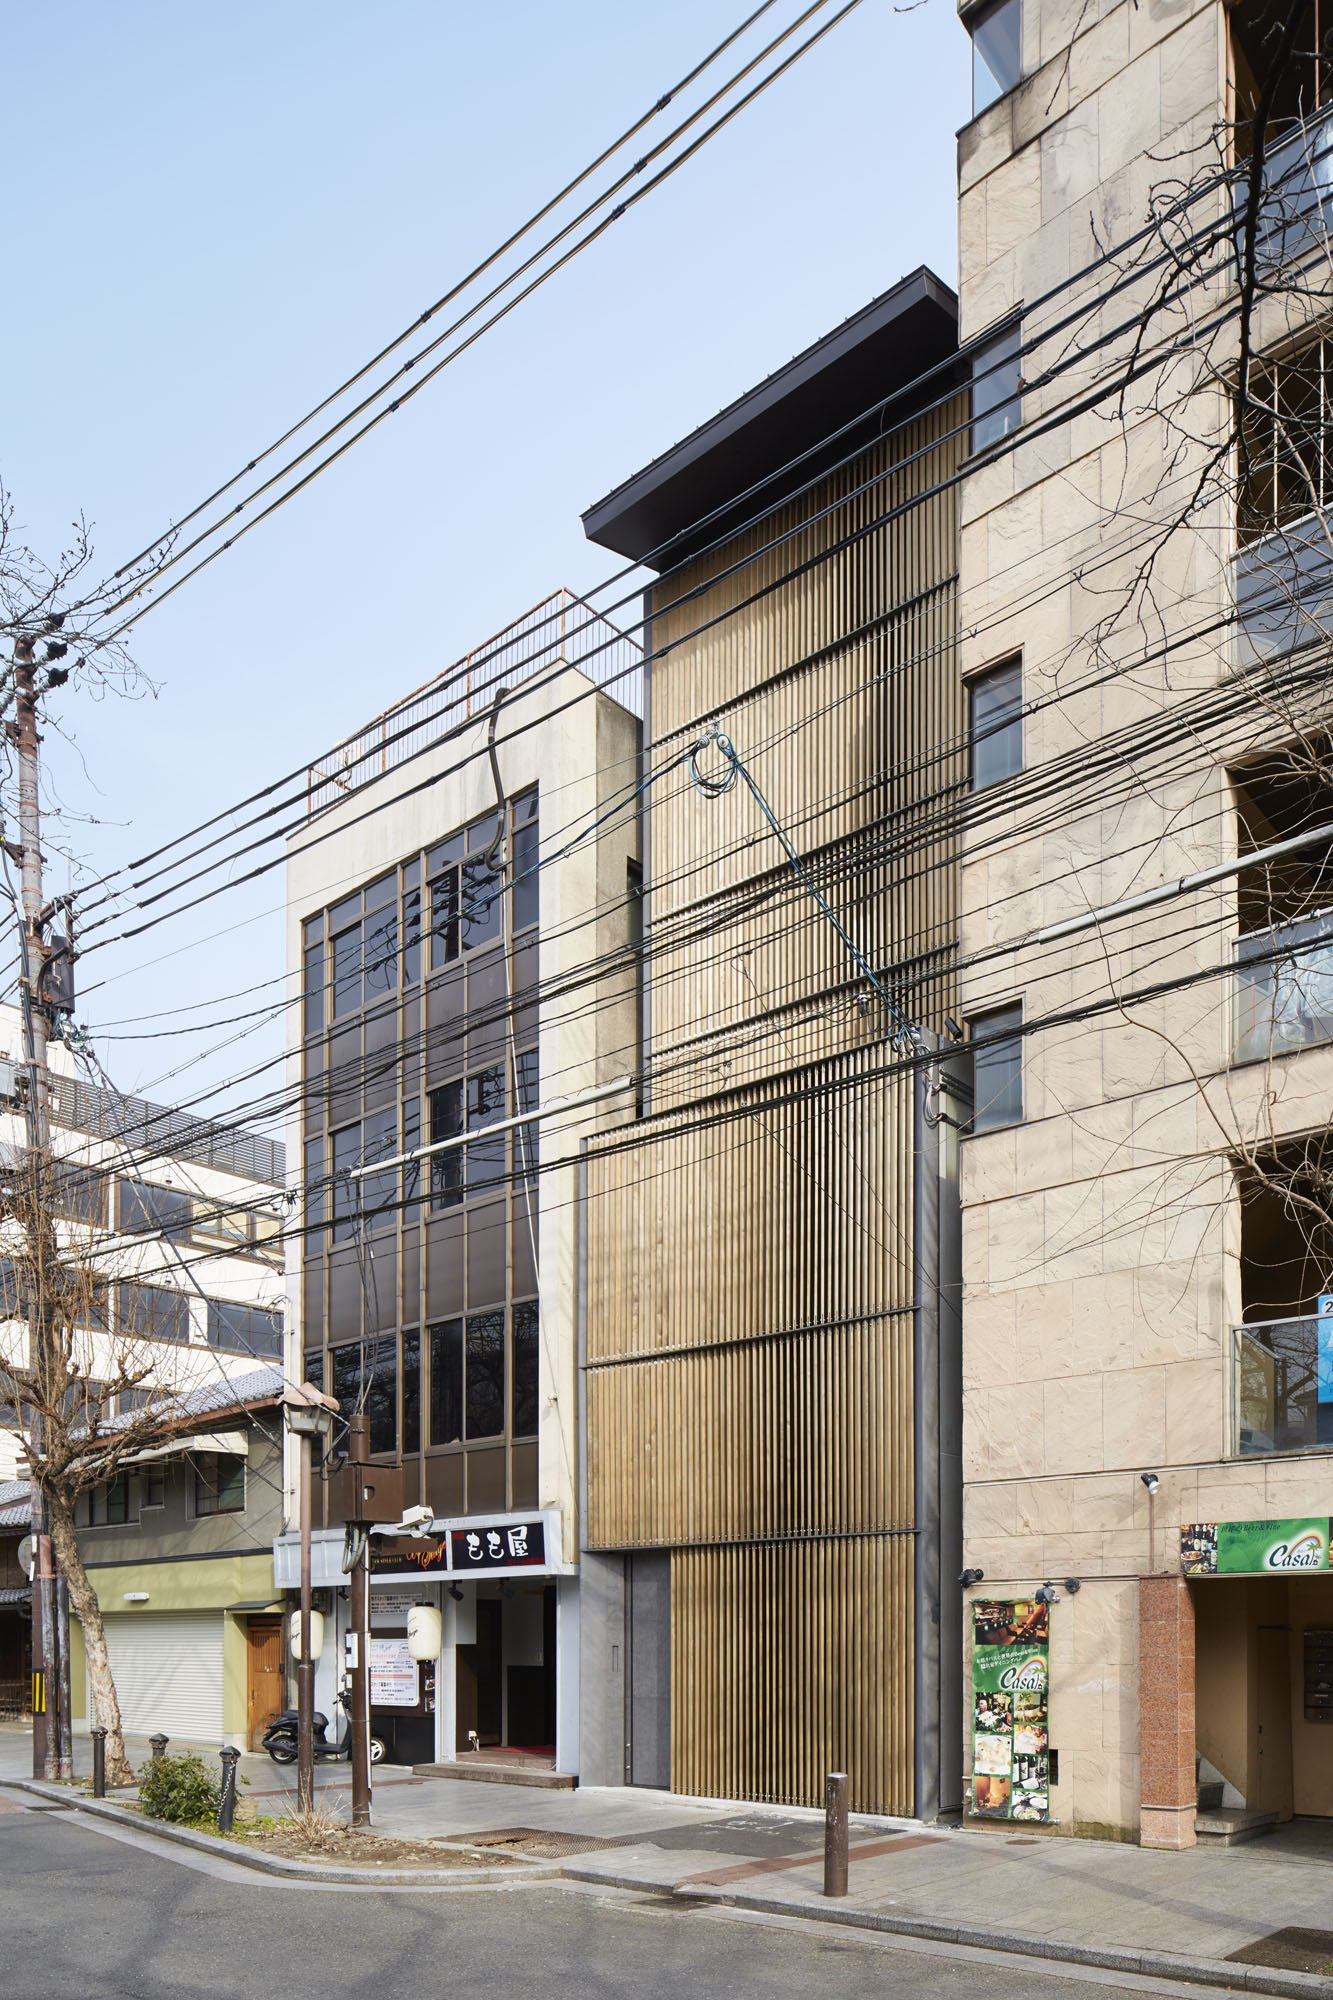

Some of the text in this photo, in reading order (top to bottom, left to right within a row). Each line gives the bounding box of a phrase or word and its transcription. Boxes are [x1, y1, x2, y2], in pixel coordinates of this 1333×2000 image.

[466, 1525, 529, 1560] もも屋
[1269, 1544, 1312, 1567] Casa
[1001, 1667, 1038, 1690] Casa
